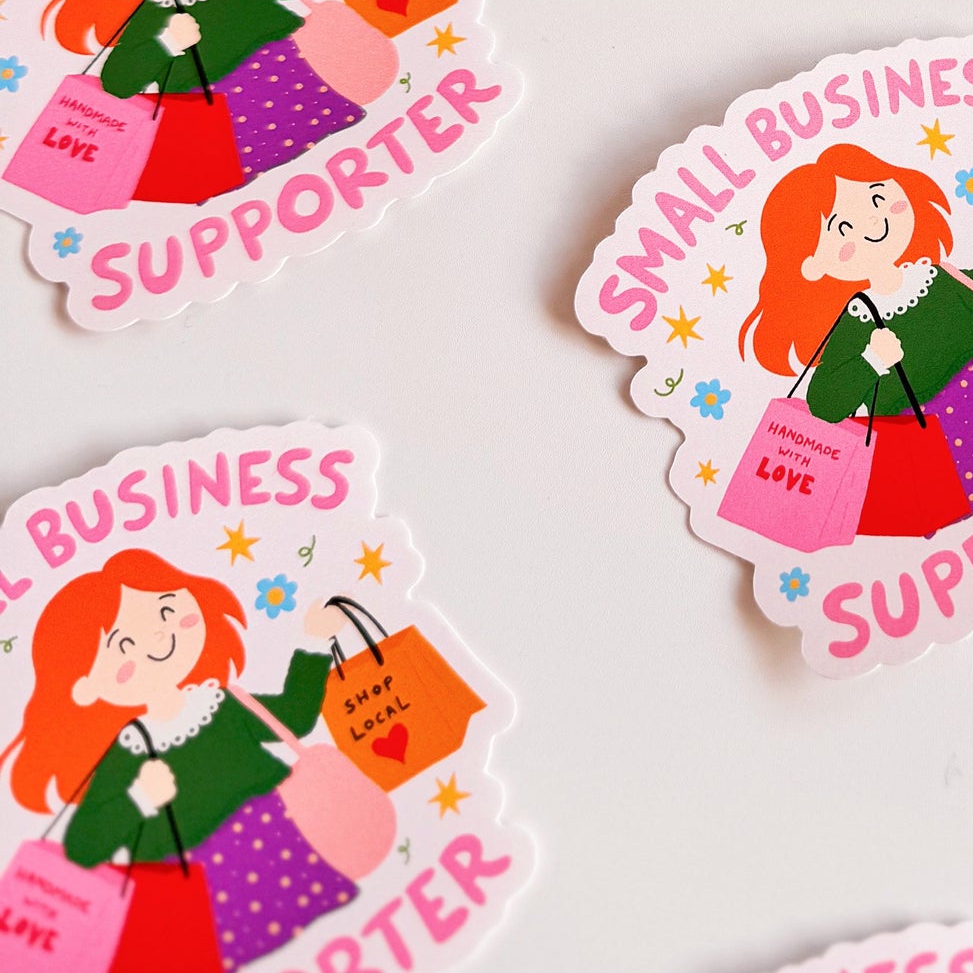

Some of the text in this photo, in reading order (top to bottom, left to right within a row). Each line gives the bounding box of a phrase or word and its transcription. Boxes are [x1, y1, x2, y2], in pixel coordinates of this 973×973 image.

[58, 95, 128, 132] HANDMADE
[65, 118, 99, 137] WITH
[42, 126, 99, 163] LOVE
[90, 68, 502, 312] SUPPORTER
[598, 145, 756, 332] SMALL
[767, 421, 841, 460] HANDMADE
[778, 446, 811, 467] WITH
[755, 456, 815, 495] LOVE
[25, 448, 354, 569] BUSINESS
[344, 675, 393, 714] SHOP
[350, 695, 411, 742] LOCAL
